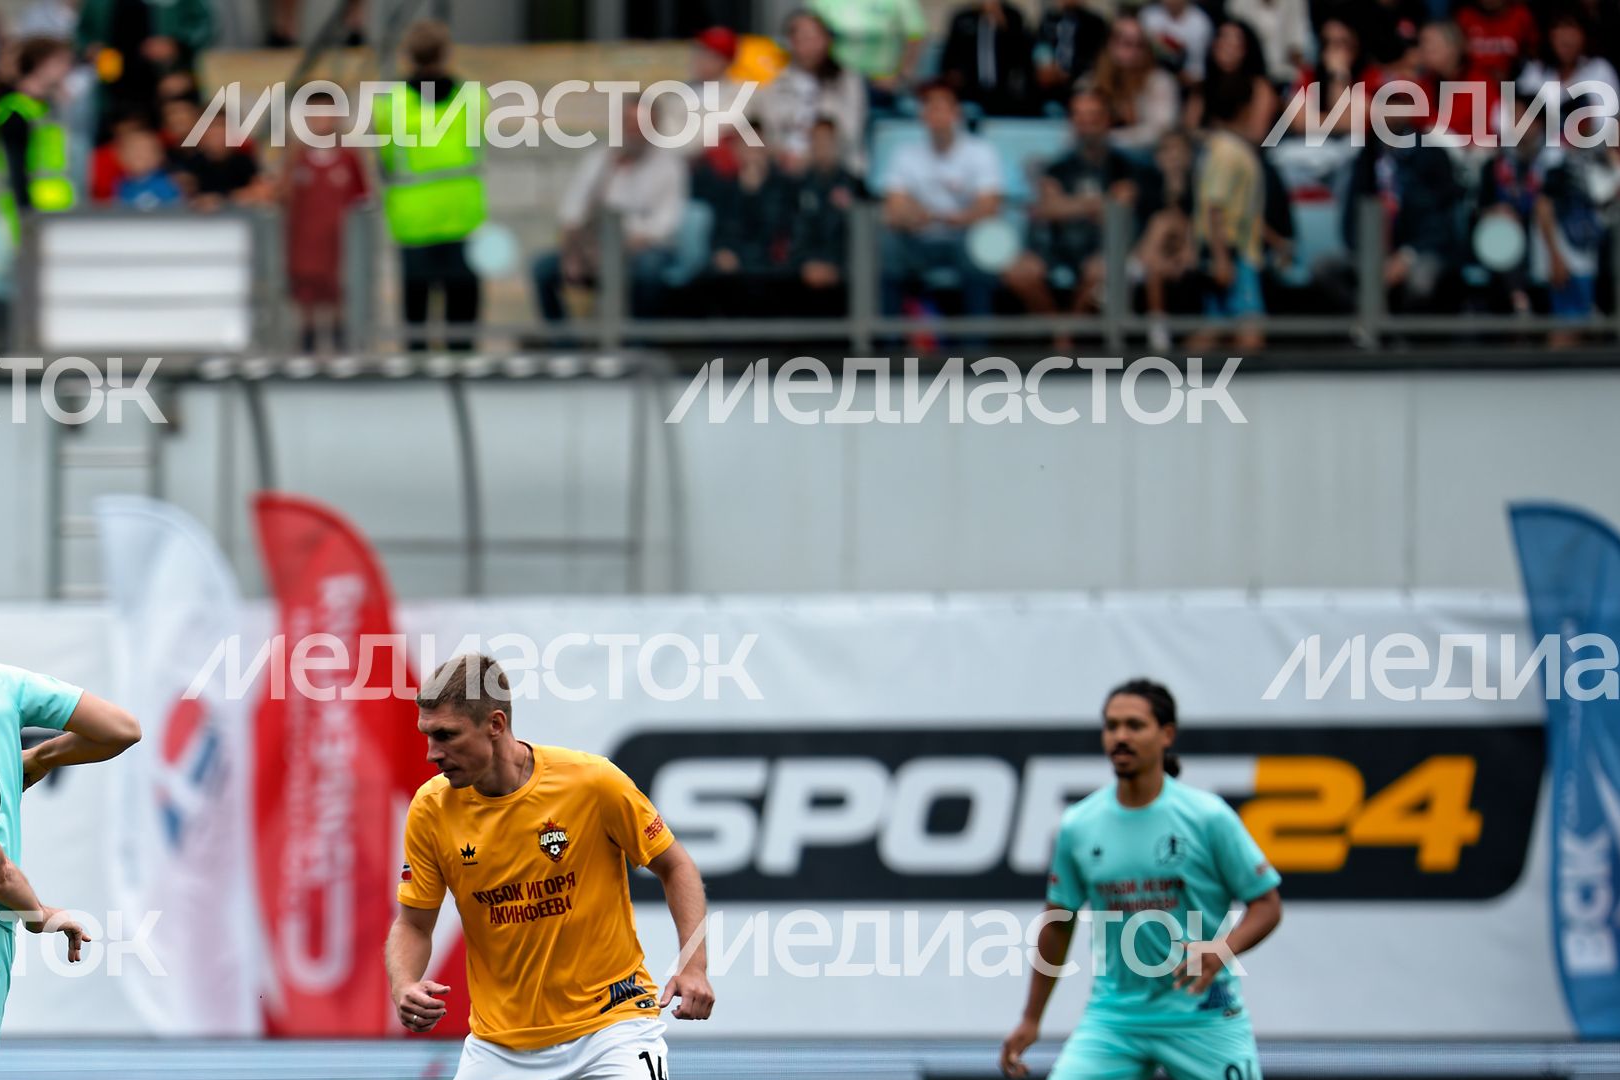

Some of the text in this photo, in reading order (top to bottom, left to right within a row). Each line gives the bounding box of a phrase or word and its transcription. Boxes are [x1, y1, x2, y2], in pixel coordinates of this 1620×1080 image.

[648, 754, 1483, 875] SPO24
[472, 871, 577, 905] КУБОК ИГОРЯ
[489, 895, 573, 925] АКИНФЕЕВА
